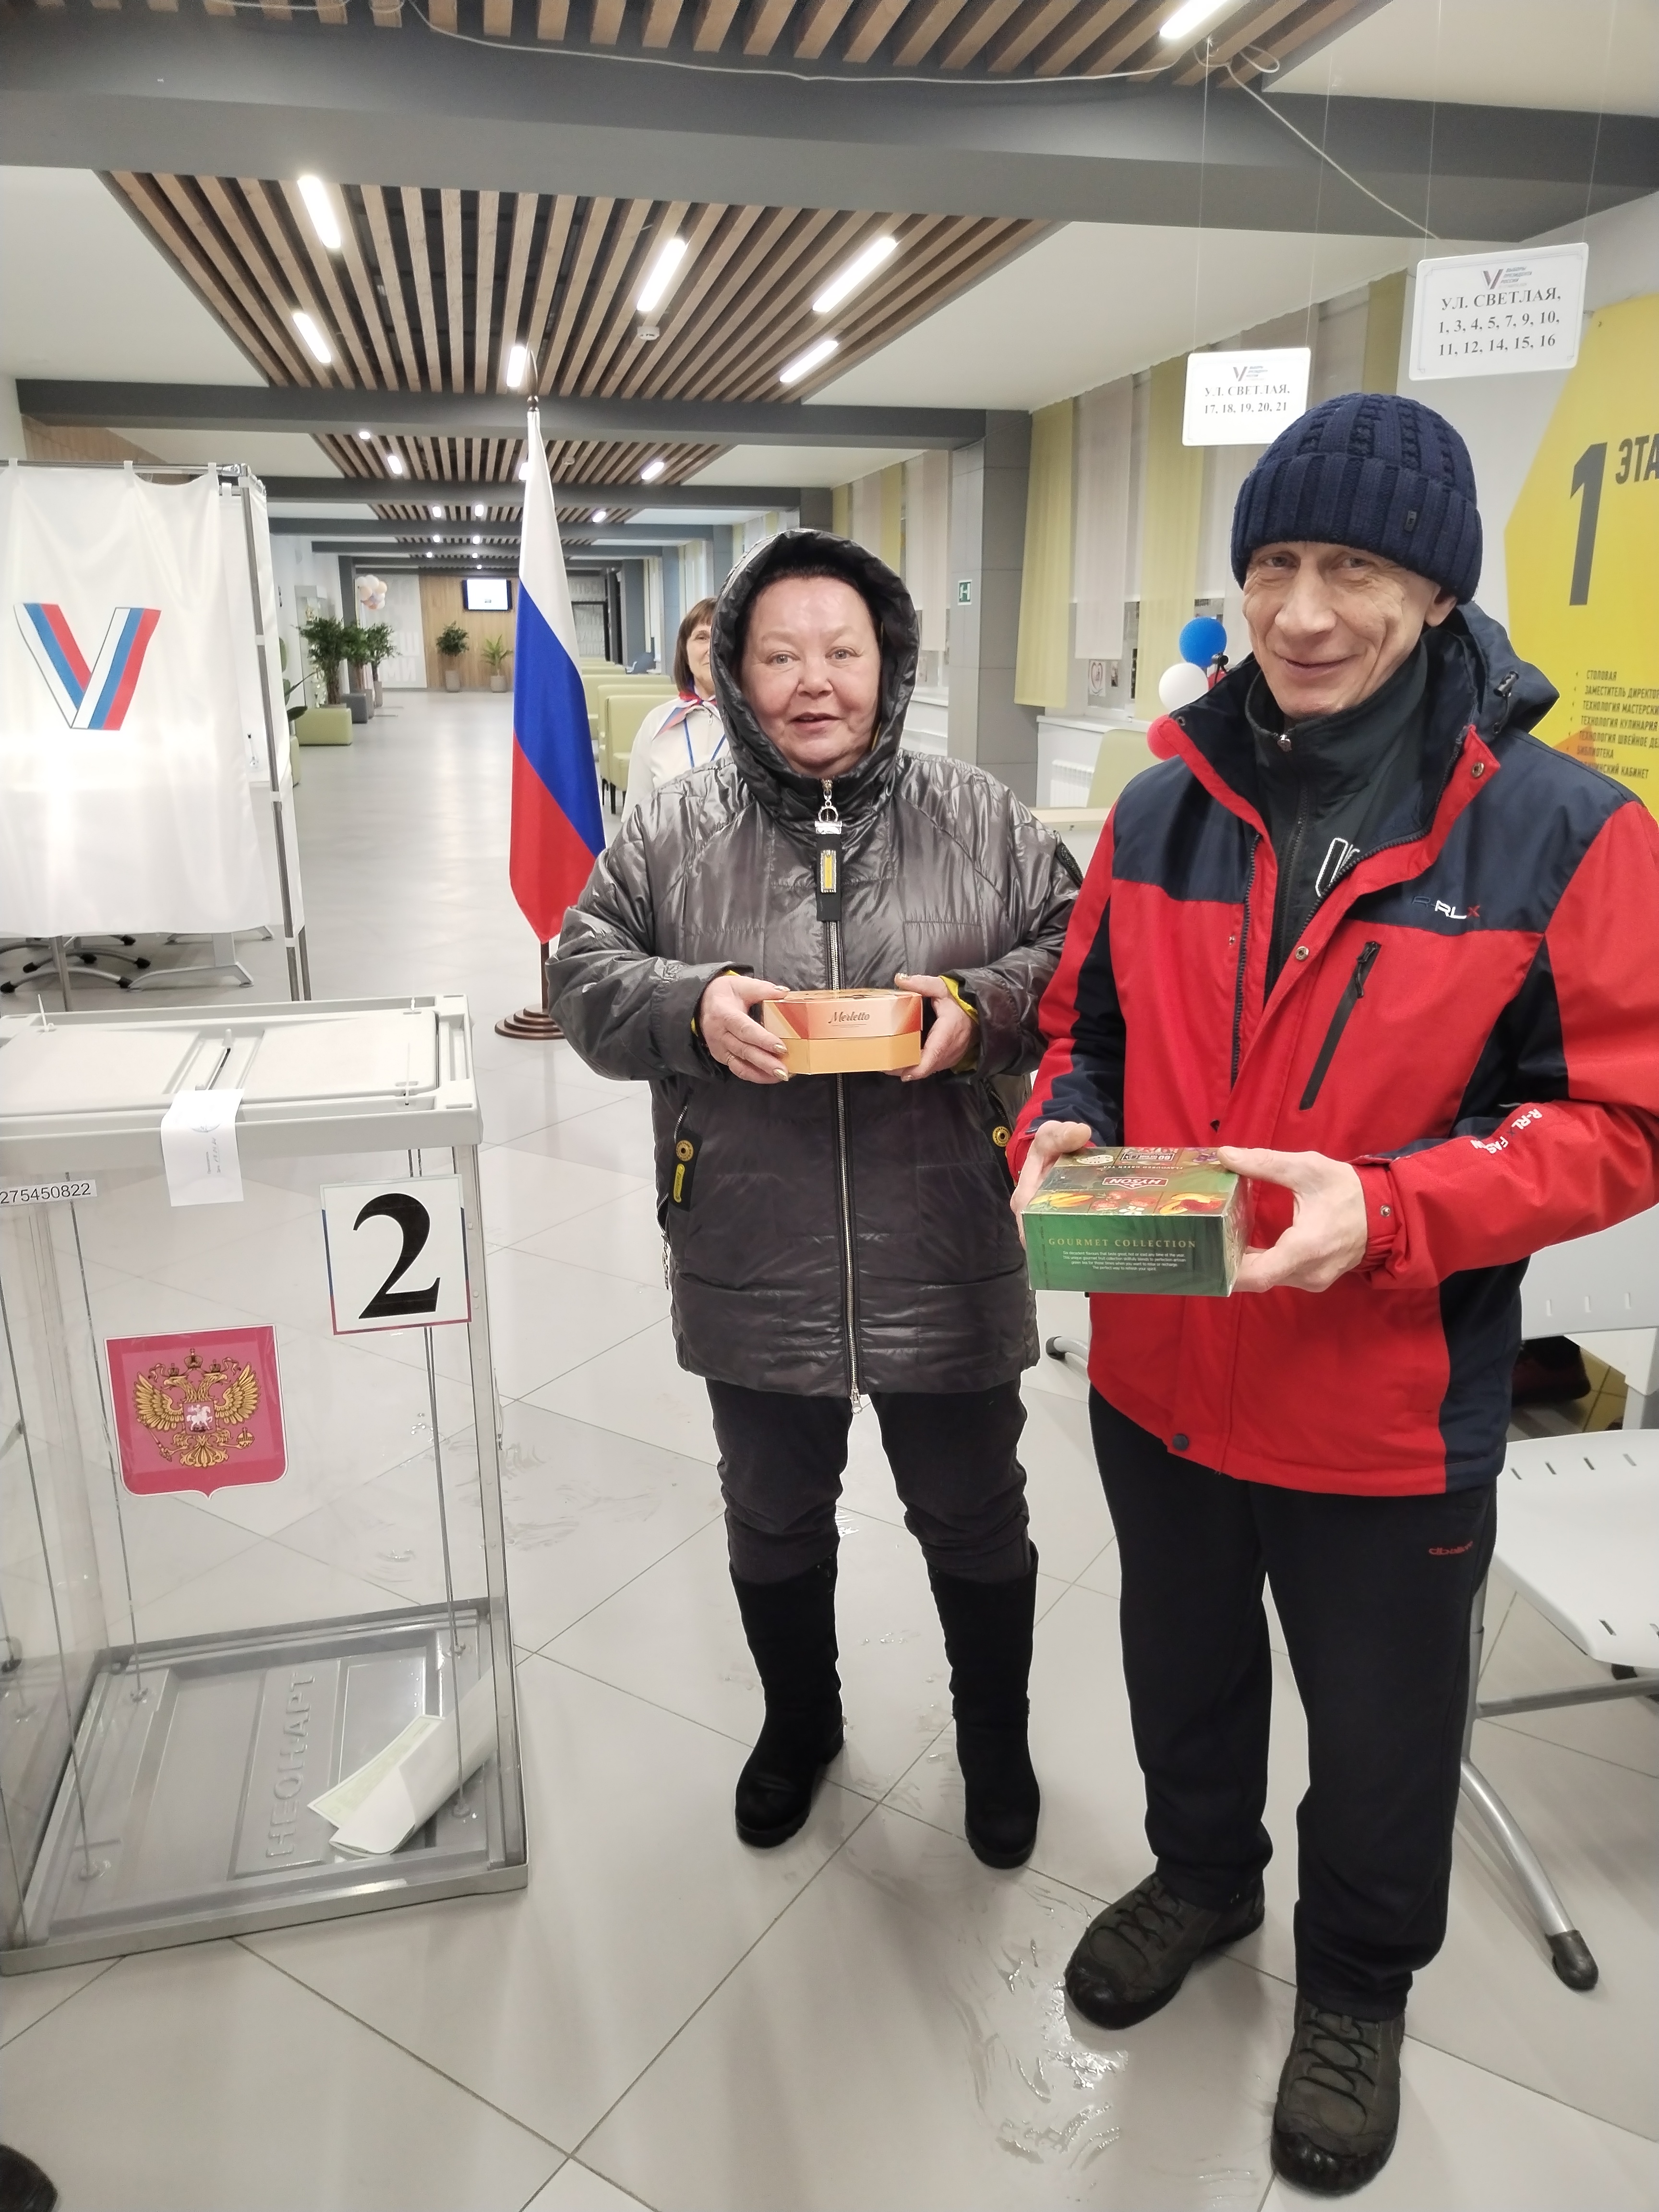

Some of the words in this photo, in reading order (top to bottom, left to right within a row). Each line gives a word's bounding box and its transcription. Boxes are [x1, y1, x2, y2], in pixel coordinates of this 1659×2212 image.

[1442, 297, 1468, 311] УЛ.
[1474, 287, 1561, 307] СВЕТЛАЯ,
[1439, 321, 1449, 334] 1,
[1454, 320, 1466, 332] 3,
[1471, 318, 1482, 331] 4,
[1488, 316, 1500, 329] 5,
[1505, 314, 1516, 328] 7,
[1522, 313, 1534, 326] 9,
[1540, 311, 1560, 325] 10,
[1439, 344, 1458, 356] 11,
[1464, 341, 1483, 354] 12,
[1489, 338, 1508, 352] 14,
[1515, 336, 1534, 350] 15,
[1540, 334, 1555, 348] 16
[1205, 387, 1224, 397] УЛ.
[1228, 384, 1290, 396] СВЕТЛАЯ,
[1276, 402, 1287, 411] 21
[1569, 442, 1608, 606] 1
[1587, 670, 1617, 681] СТОЛОВАЯ
[1585, 685, 1626, 697] ЗАМЕСТИТЕЛЬ
[1583, 700, 1621, 712] ТЕХНОЛОГИЯ
[1581, 715, 1618, 728] ТЕХНОЛОГИЯ
[1619, 719, 1658, 732] КУЛИНАРИЯ
[1618, 733, 1648, 747] ШВЕЙНОЕ
[1621, 766, 1649, 779] КАБИНЕТ
[828, 1011, 870, 1024] Merletto
[0, 1182, 91, 1204] 275450822
[1115, 1239, 1196, 1248] COLLECTION
[353, 1193, 440, 1319] 2
